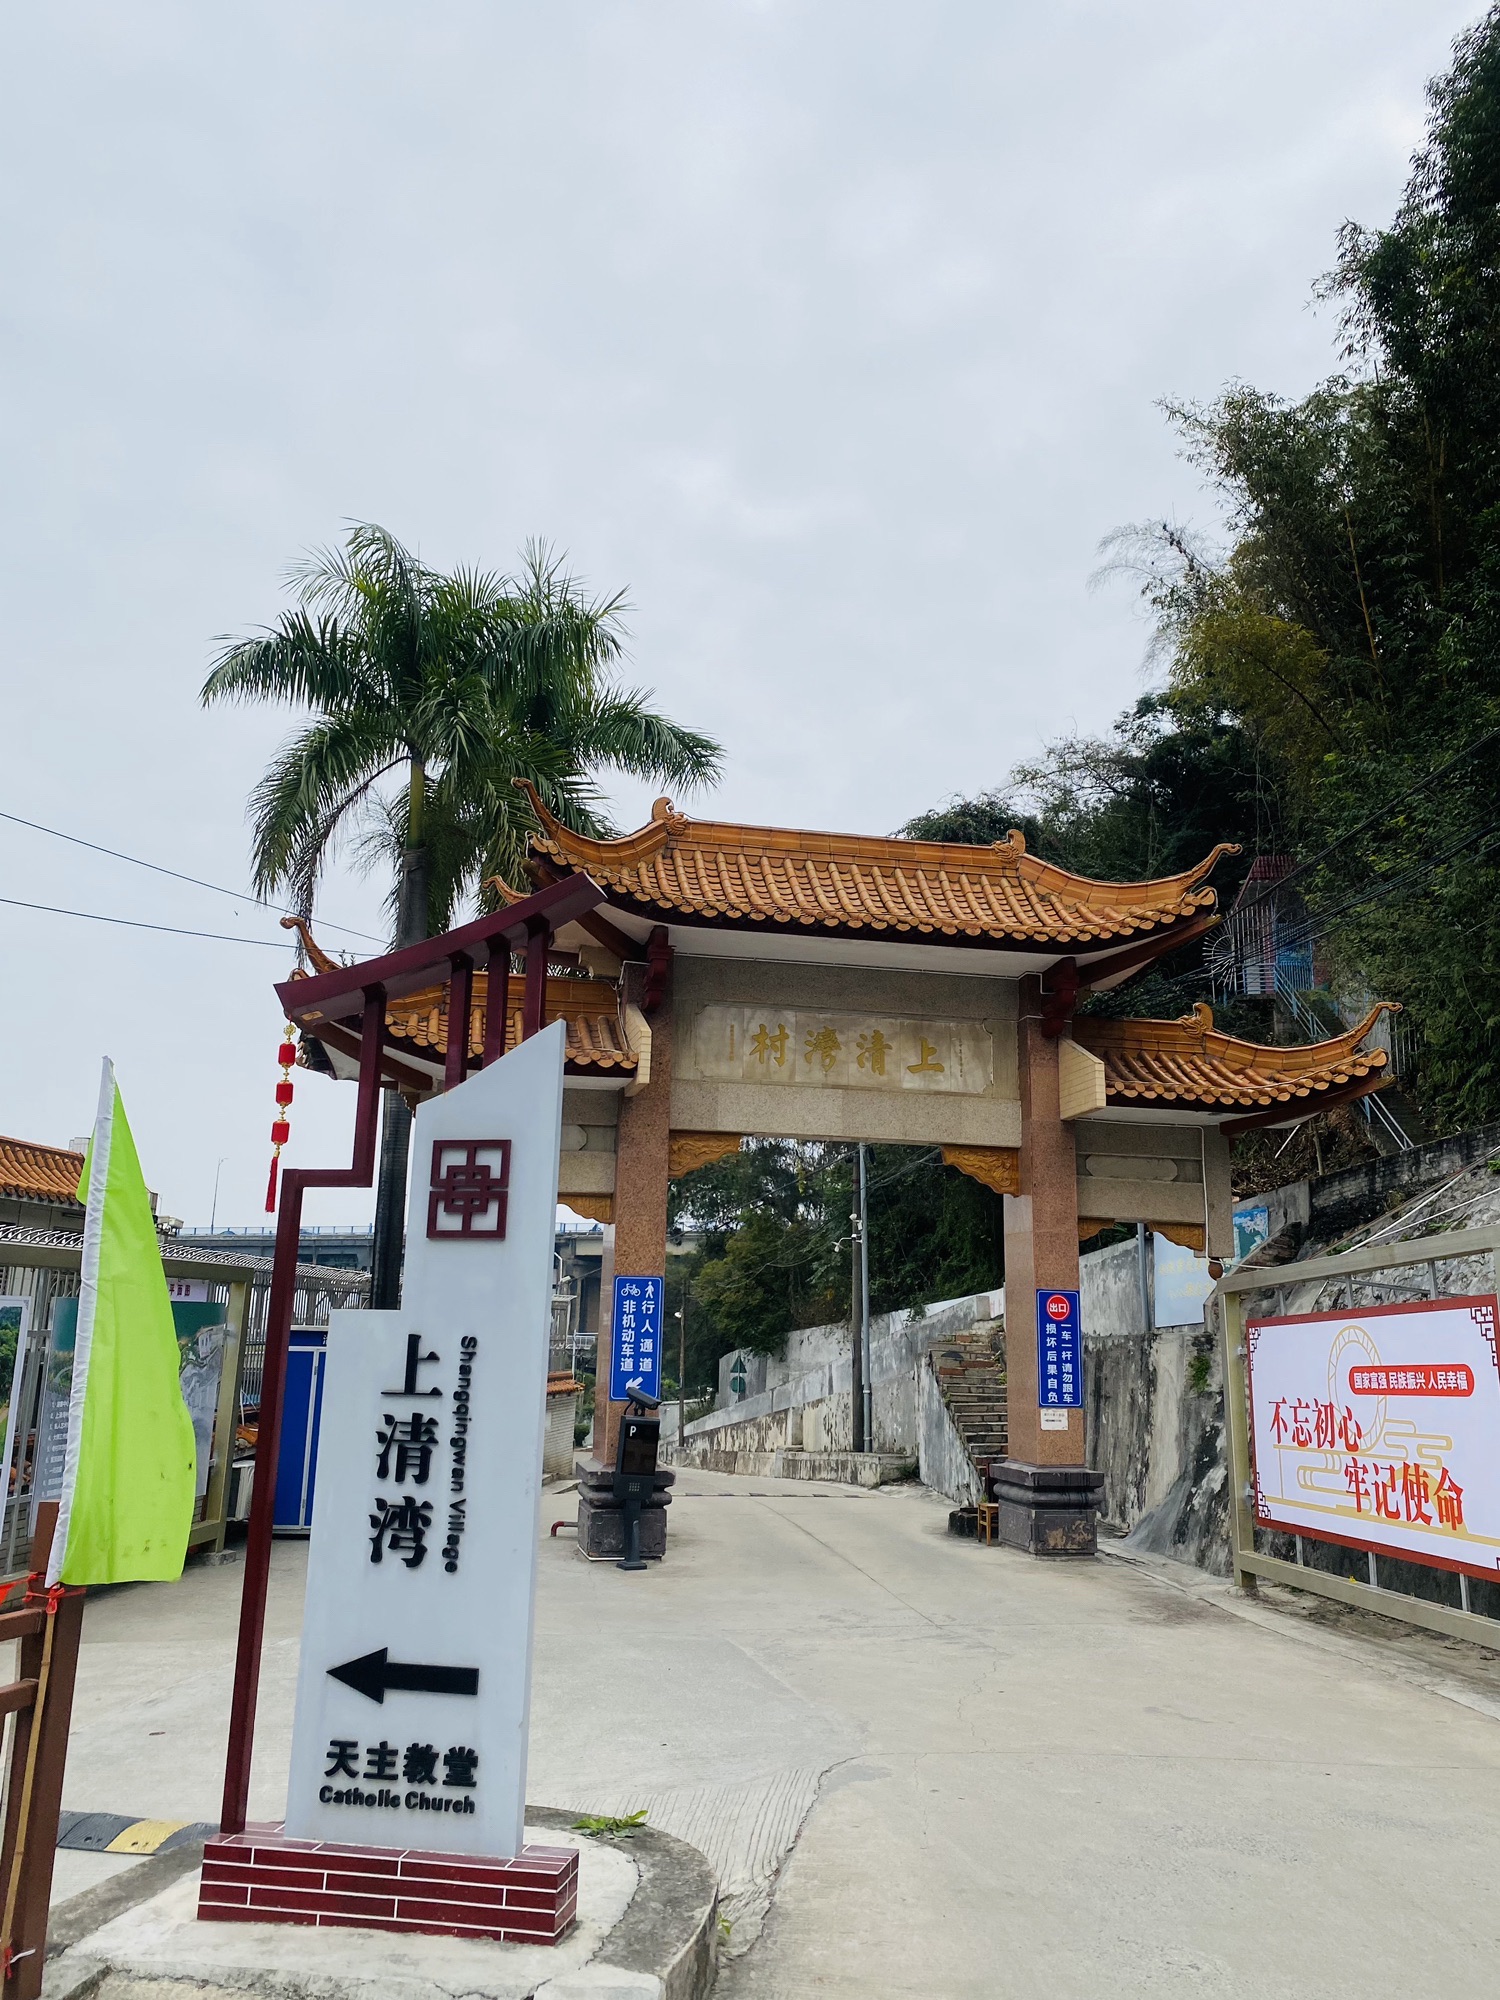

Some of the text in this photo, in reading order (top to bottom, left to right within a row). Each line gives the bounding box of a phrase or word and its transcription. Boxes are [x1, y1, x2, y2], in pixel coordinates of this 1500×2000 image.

[620, 1299, 636, 1372] 非机动车道
[639, 1300, 655, 1372] 行人通道
[1049, 1302, 1067, 1313] 出口
[1045, 1323, 1059, 1403] 损坏后果自负
[1353, 1371, 1468, 1390] 国家富强 民族振兴 人民幸福
[369, 1334, 443, 1568] 上清湾
[442, 1335, 478, 1573] Shangqingwan Village
[629, 1425, 637, 1437] P
[1268, 1396, 1363, 1453] 不忘初心
[1344, 1456, 1464, 1531] 牢记使命
[324, 1740, 479, 1787] 天主教堂
[319, 1785, 475, 1814] Catholic Church
